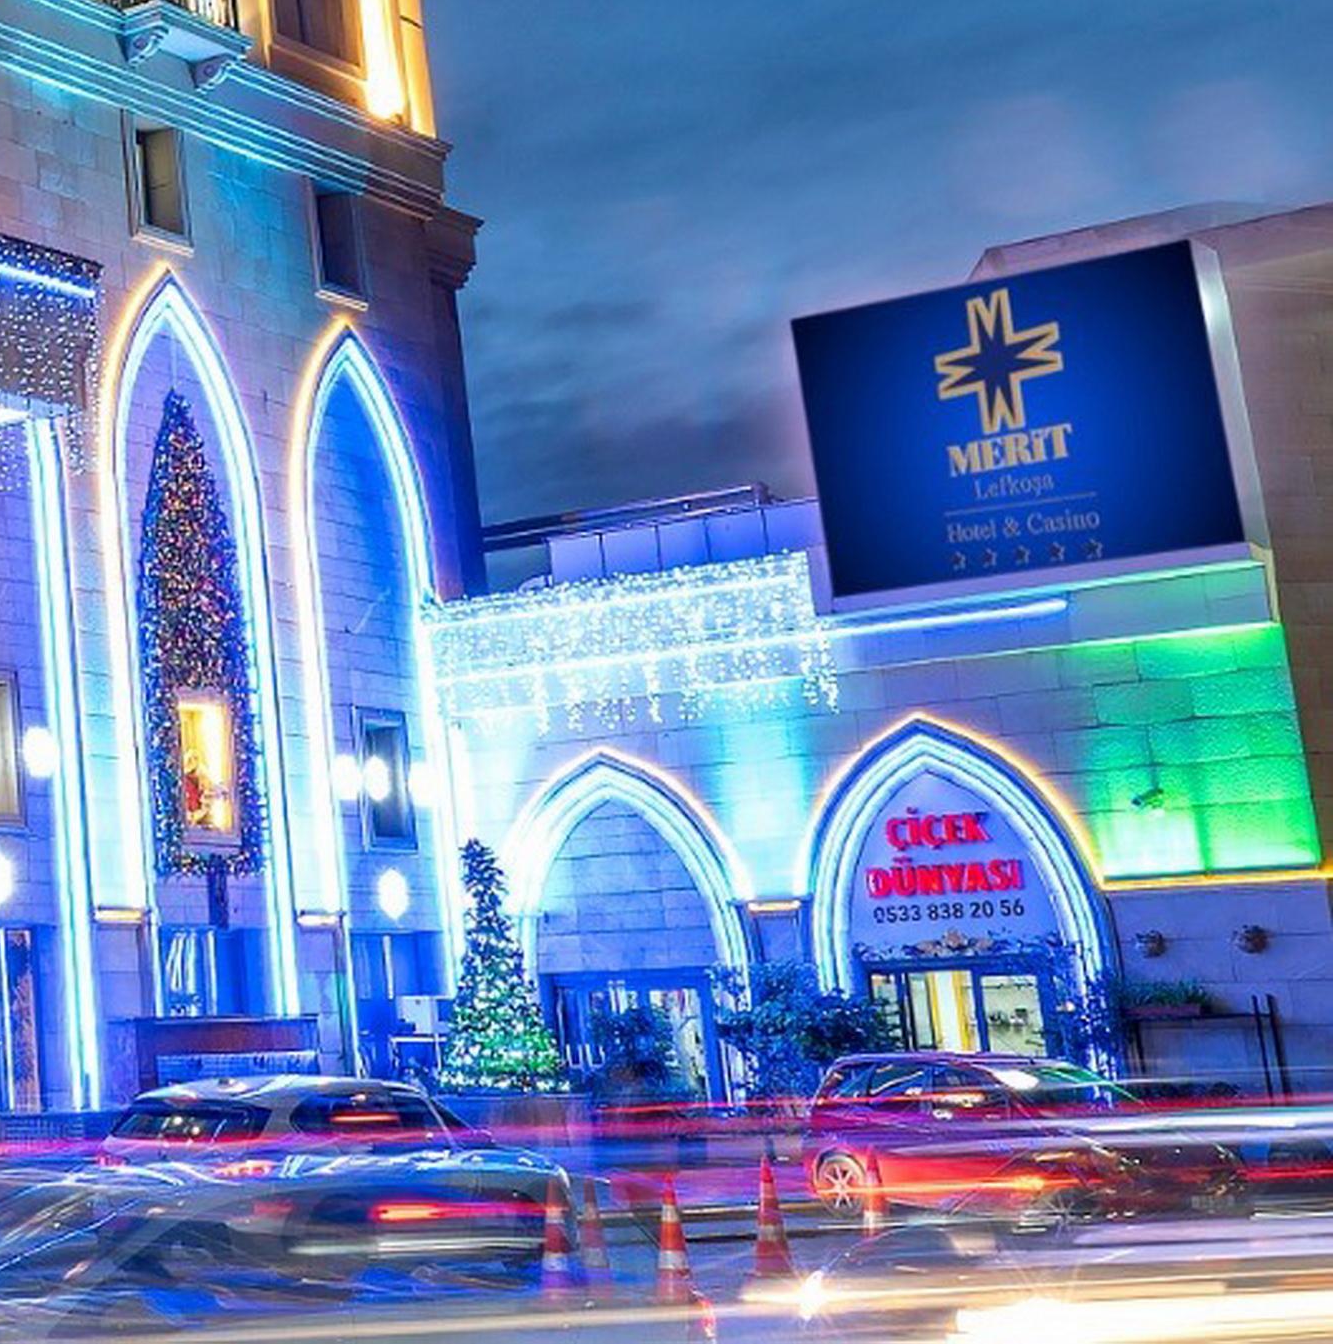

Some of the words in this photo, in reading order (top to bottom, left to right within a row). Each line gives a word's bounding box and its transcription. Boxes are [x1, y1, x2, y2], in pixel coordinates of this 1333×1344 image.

[946, 519, 997, 543] Hotel
[1003, 516, 1021, 537] &
[1027, 509, 1100, 534] Casino
[886, 807, 993, 851] ÇİÇEK
[866, 856, 1024, 899] DÜNYASI
[873, 904, 922, 923] 0533
[927, 901, 964, 921] 838
[970, 899, 994, 918] 20
[999, 897, 1025, 916] 56
